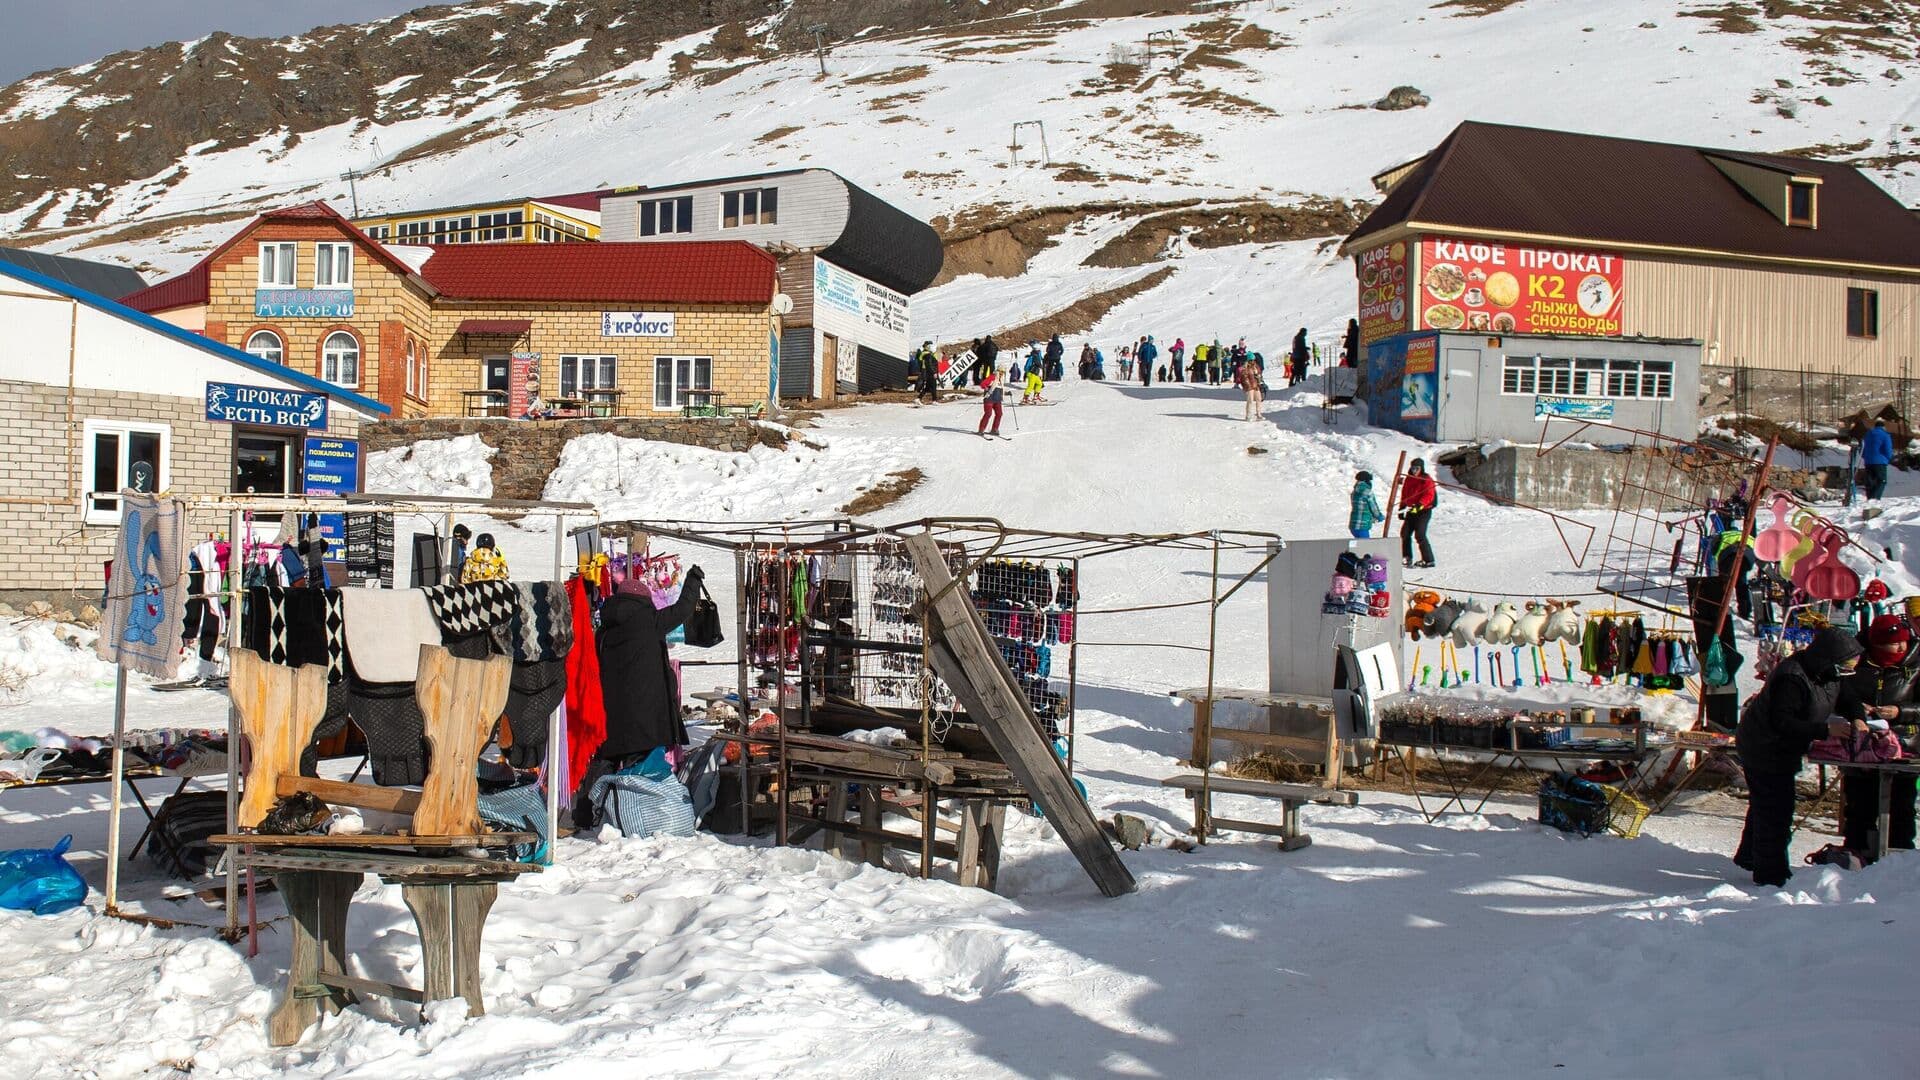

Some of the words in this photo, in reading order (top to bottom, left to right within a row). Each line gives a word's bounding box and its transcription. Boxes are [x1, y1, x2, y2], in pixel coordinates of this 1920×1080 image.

[1362, 245, 1390, 265] КАФЕ
[1435, 239, 1506, 265] КАФЕ
[1519, 248, 1616, 274] ПРОКАТ
[282, 305, 332, 316] КАФЕ
[1361, 301, 1391, 319] ПРОКАТ
[1525, 313, 1618, 332] -СНОУБОРДЫ
[1408, 340, 1435, 350] ПРОКАТ
[236, 388, 301, 407] ПРОКАТ
[225, 406, 272, 424] ЕСТЬ
[276, 411, 310, 427] ВСЕ
[321, 441, 344, 449] ДОБРО
[307, 473, 342, 484] СНОУБОРДЫ
